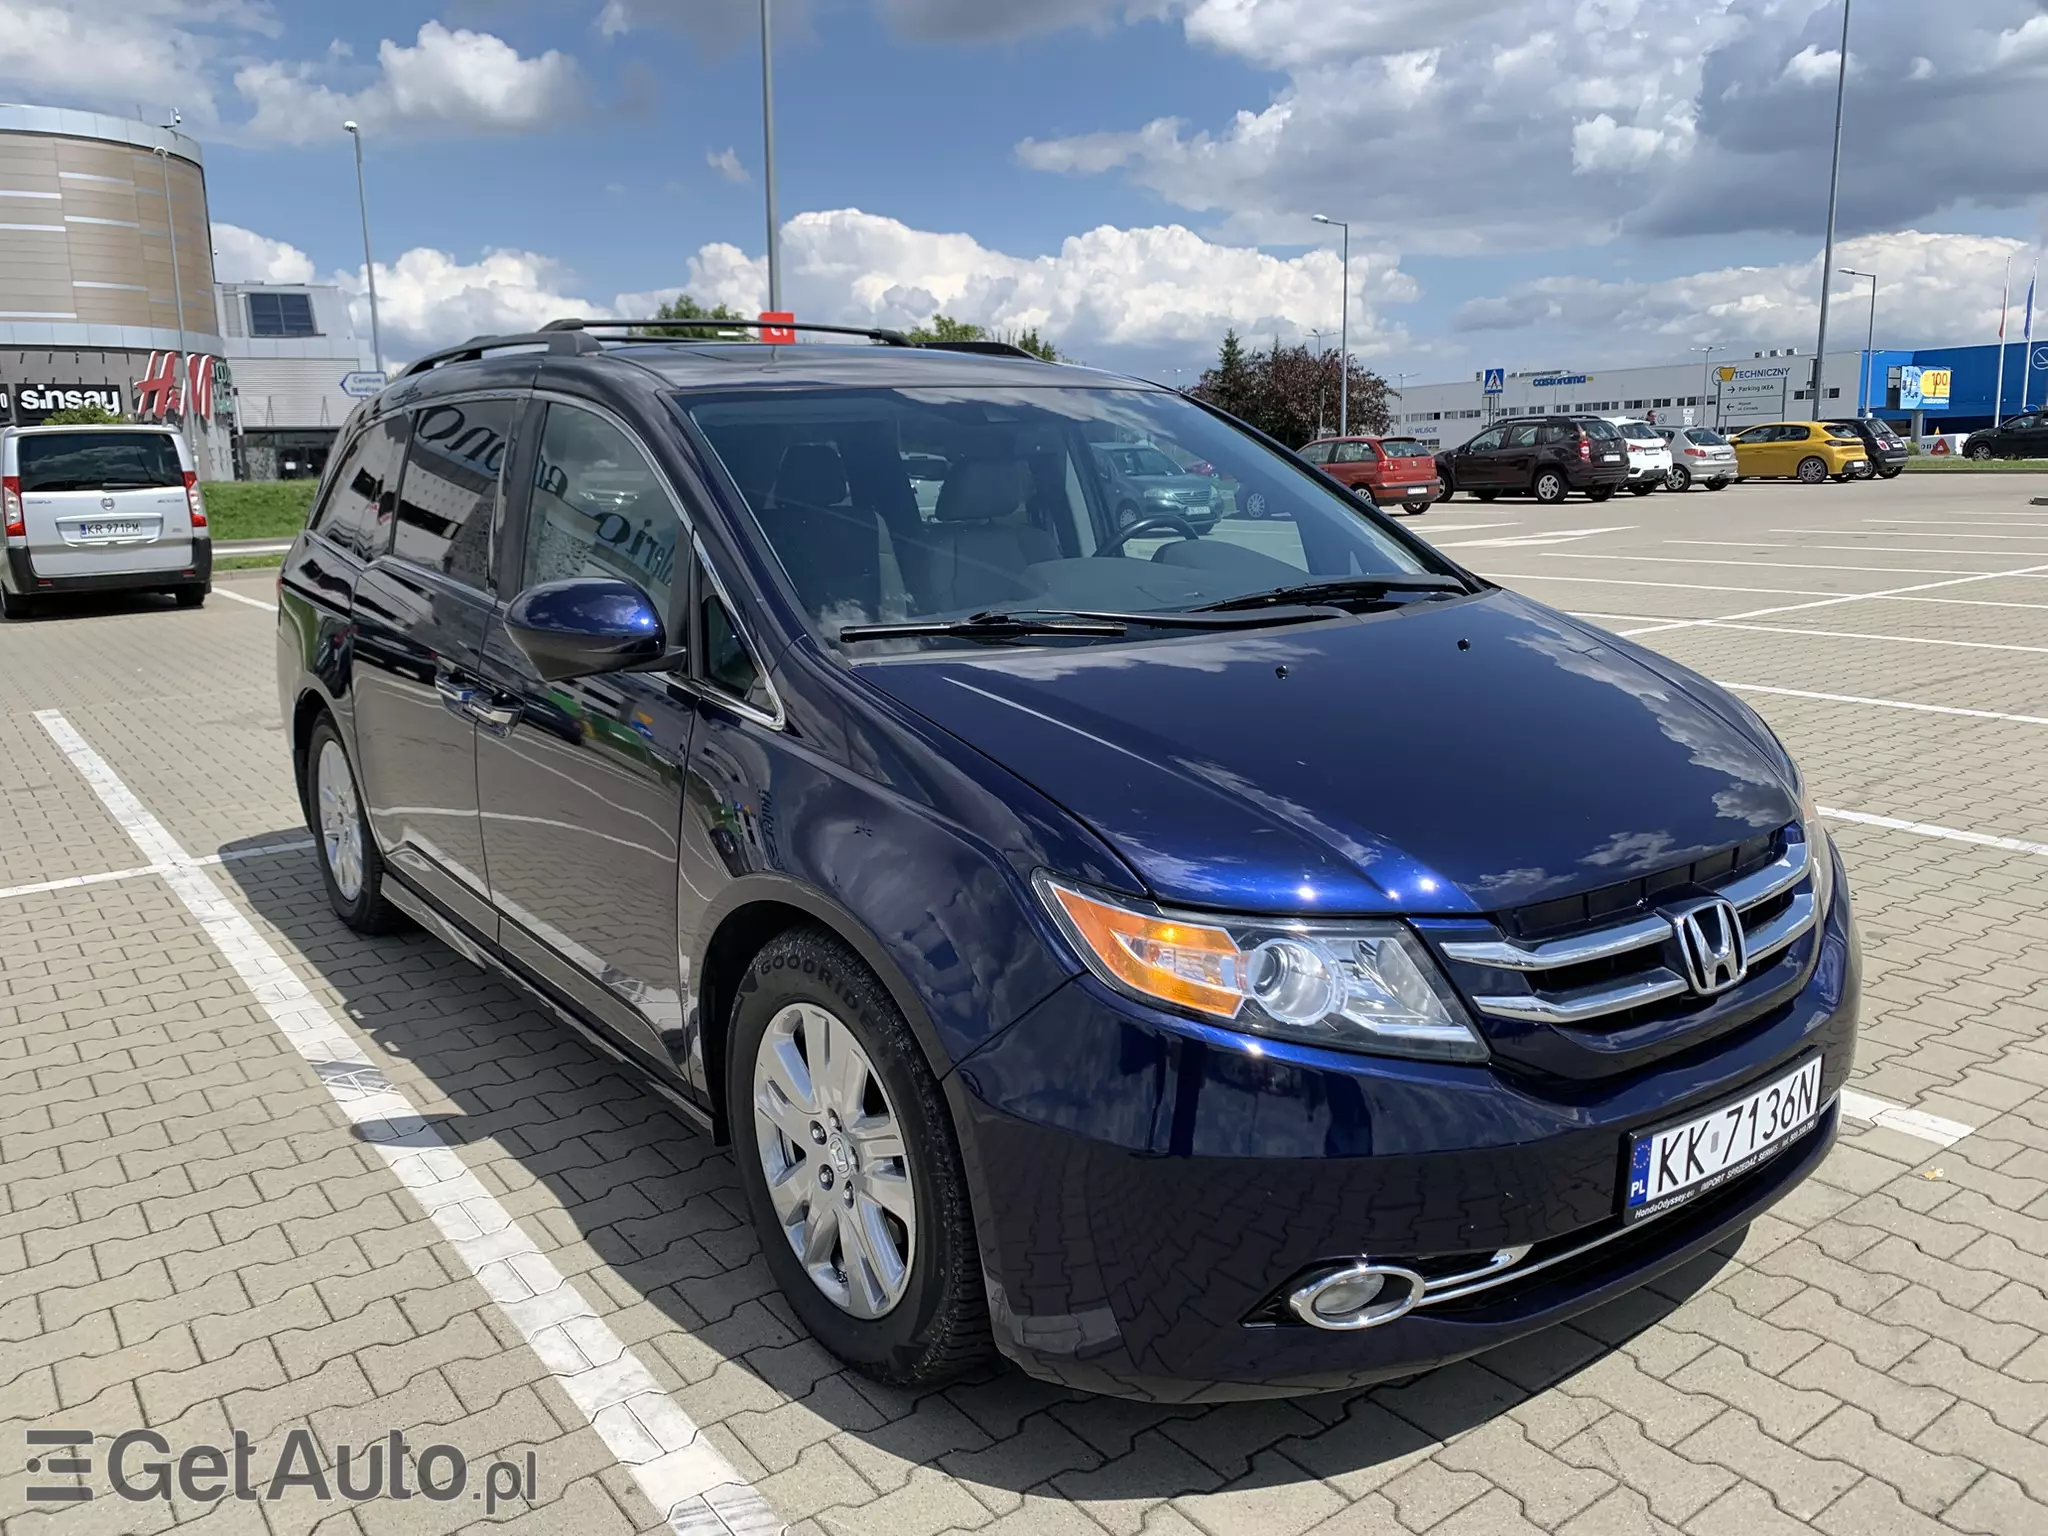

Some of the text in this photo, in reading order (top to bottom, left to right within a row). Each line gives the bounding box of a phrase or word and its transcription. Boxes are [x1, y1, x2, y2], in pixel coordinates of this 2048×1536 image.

[1734, 367, 1791, 379] TECHNICZNY
[1932, 372, 1948, 386] 100
[134, 350, 213, 420] H&M
[1738, 385, 1760, 393] Parking
[20, 384, 120, 417] sinsay
[1657, 1064, 1816, 1193] KK 7136N
[1631, 1181, 1646, 1198] PL
